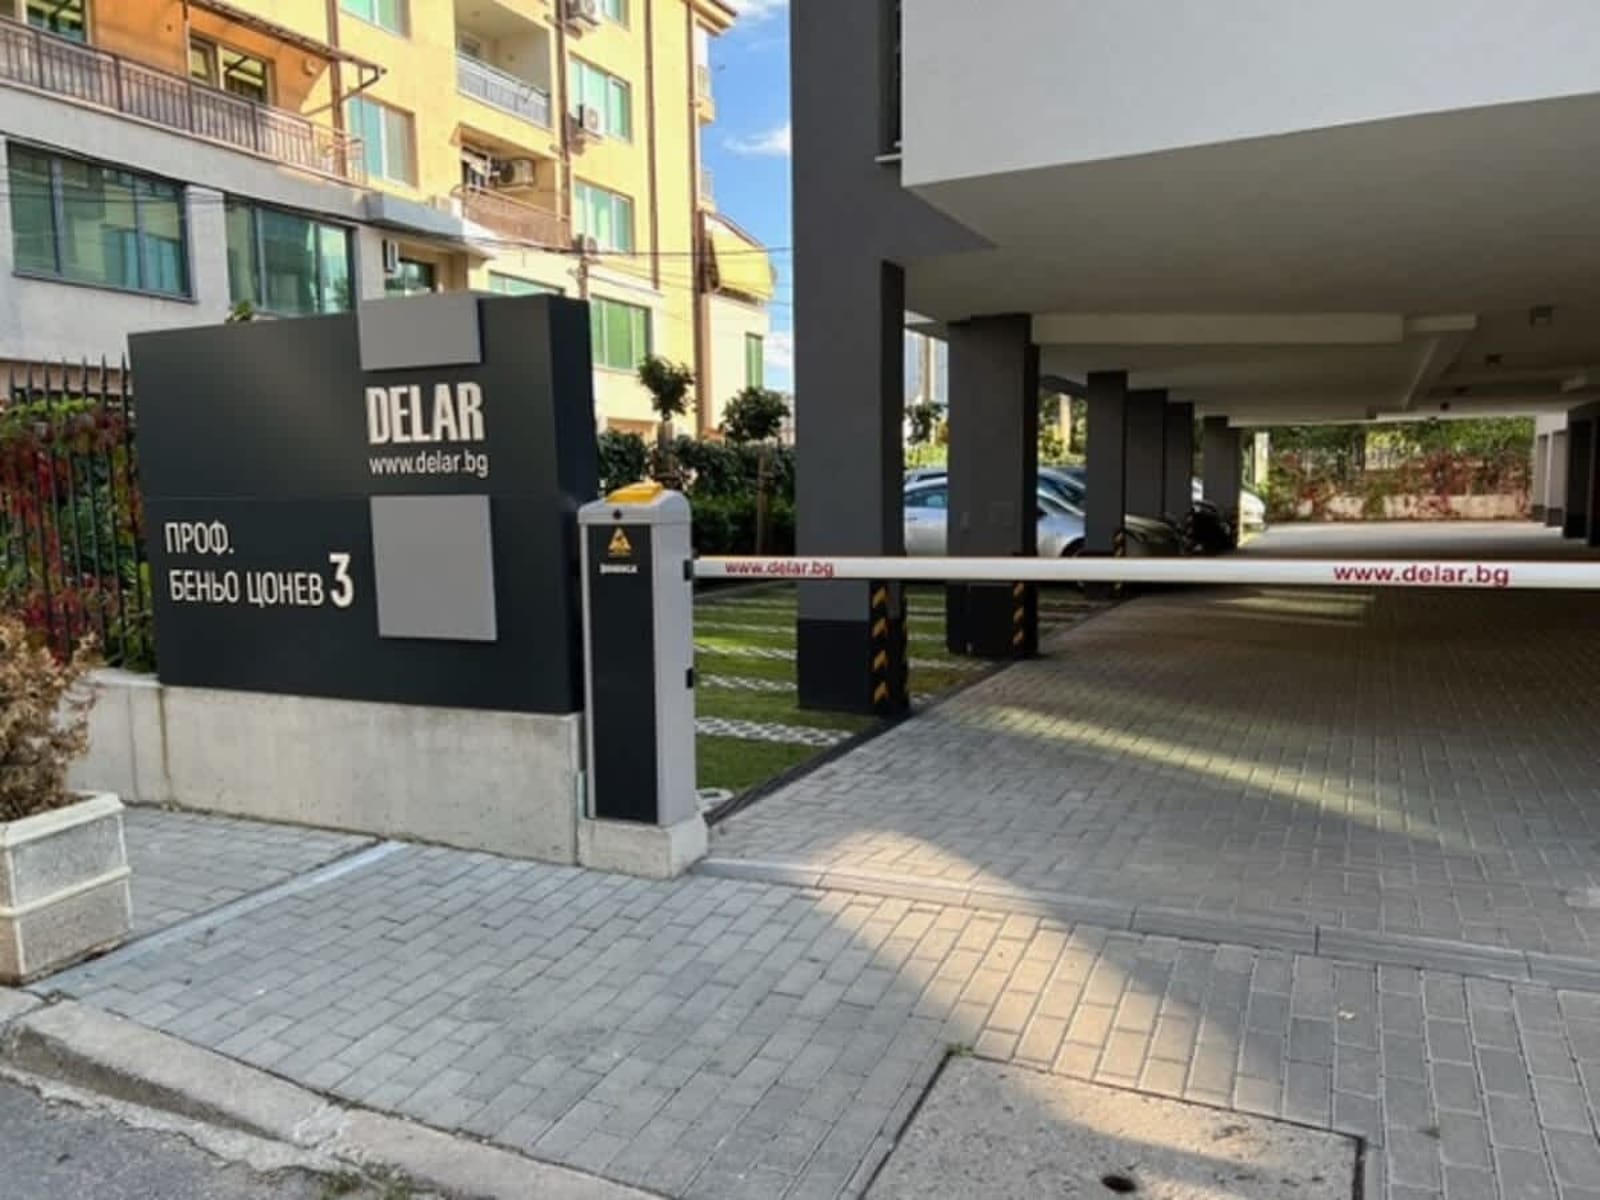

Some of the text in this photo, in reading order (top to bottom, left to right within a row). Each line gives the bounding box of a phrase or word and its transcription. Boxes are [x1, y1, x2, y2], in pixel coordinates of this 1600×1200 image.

[365, 382, 485, 445] DELAR
[369, 450, 488, 478] www.delar.bg
[165, 520, 235, 555] ПРОФ.
[169, 553, 354, 608] БЕНЬО ЦОНЕВ 3
[724, 559, 834, 577] www.delar.bg
[1333, 565, 1509, 586] www.delar.bg
